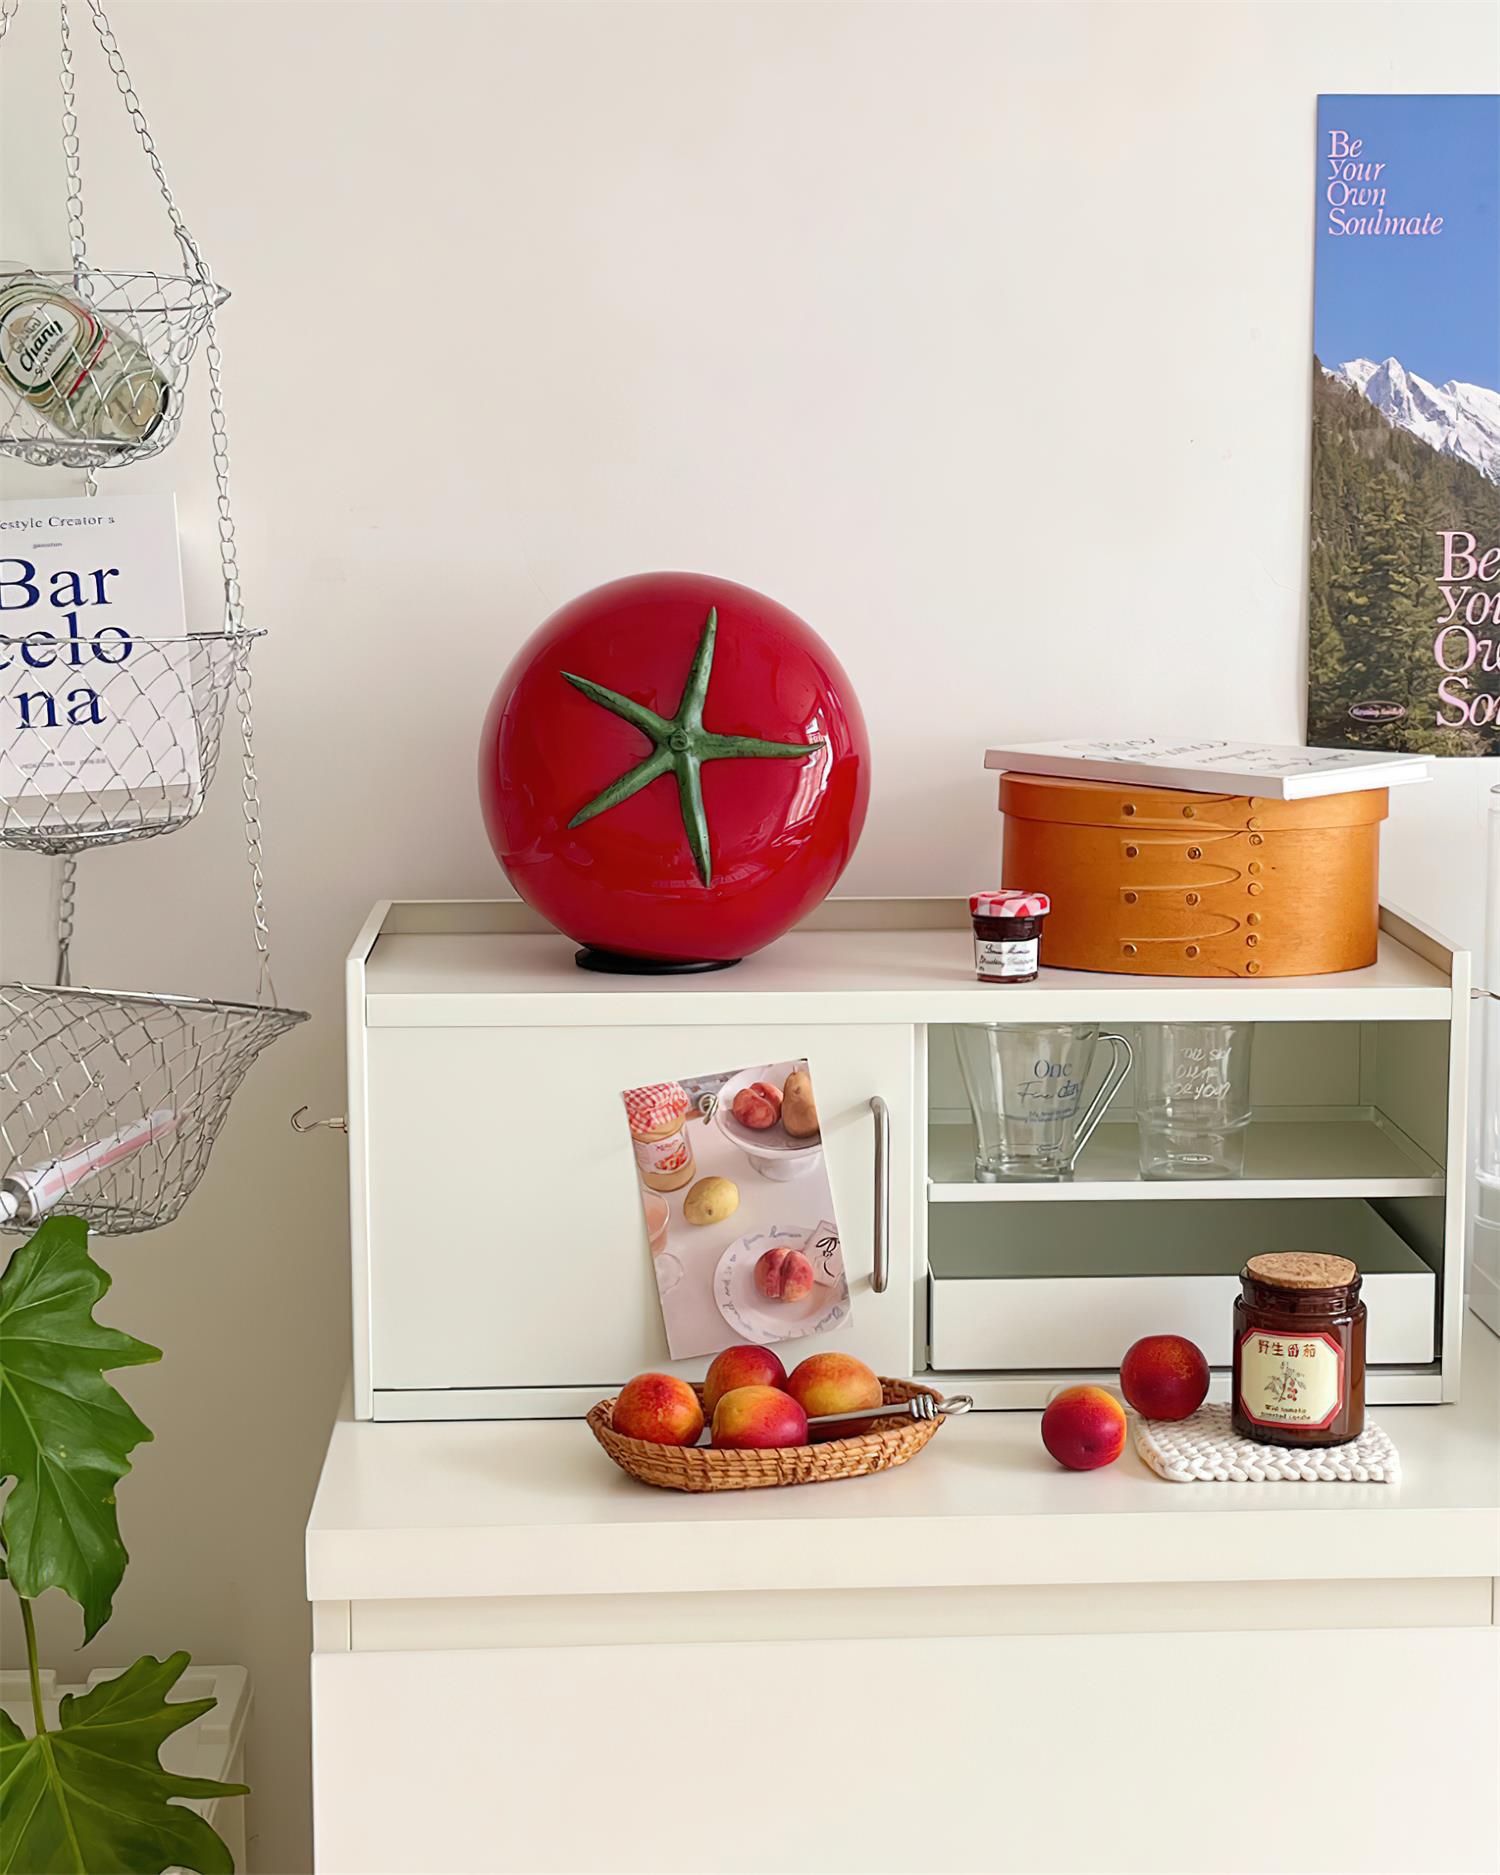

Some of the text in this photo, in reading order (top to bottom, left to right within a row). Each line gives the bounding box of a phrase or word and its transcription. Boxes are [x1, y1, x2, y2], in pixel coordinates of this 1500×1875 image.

[1327, 130, 1363, 158] Be
[1327, 180, 1387, 206] Own
[1328, 207, 1444, 236] Soulmate
[1435, 531, 1500, 582] Be
[0, 558, 120, 611] Bar
[14, 687, 108, 730] na
[1257, 1338, 1316, 1358] 野生番茄
